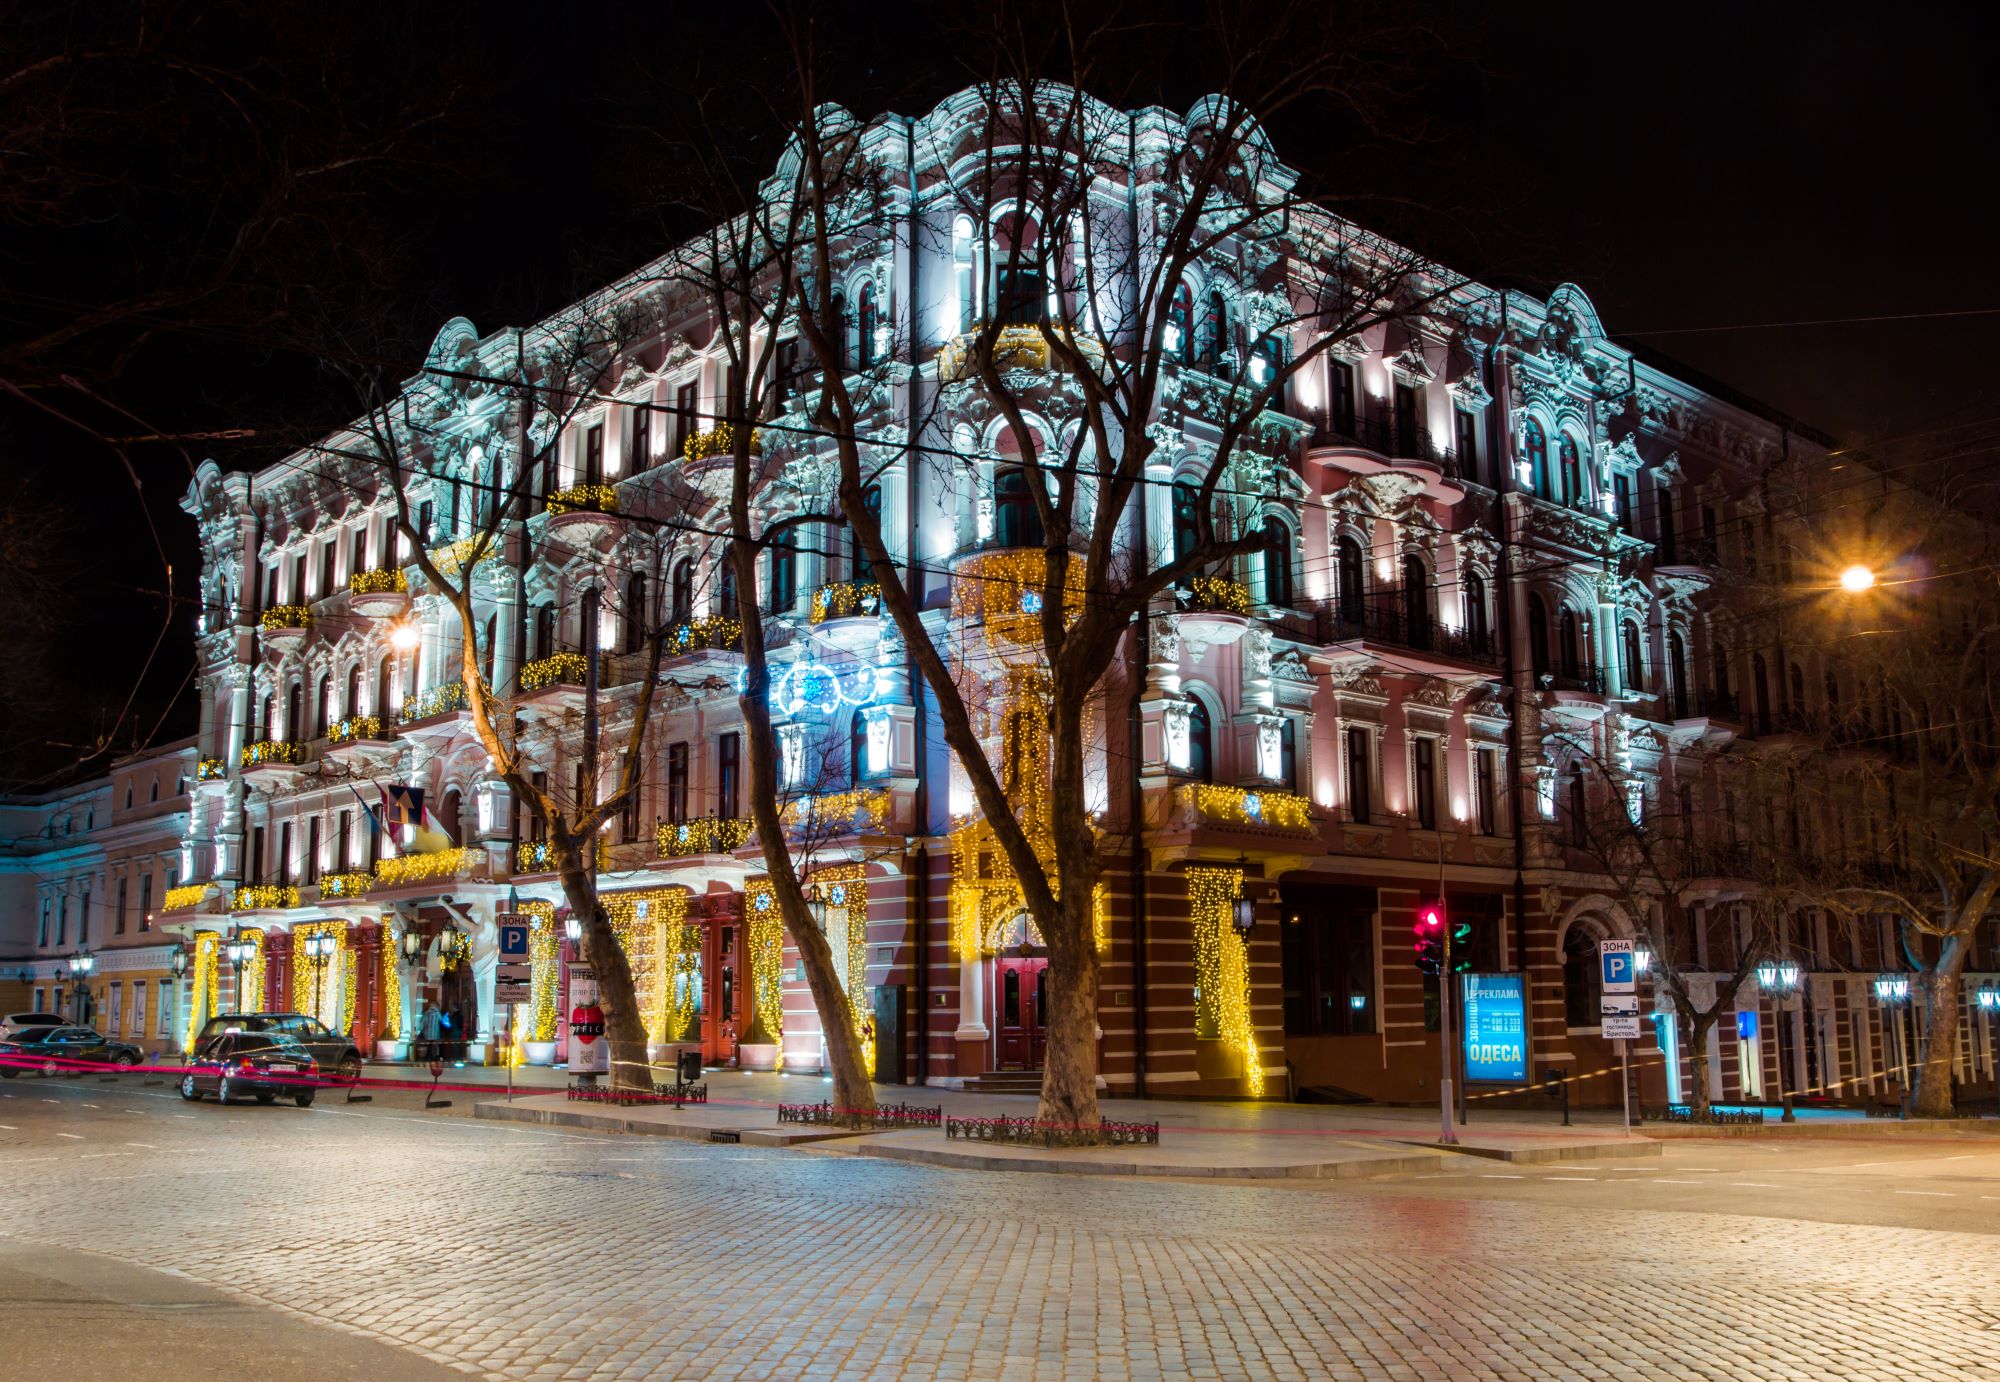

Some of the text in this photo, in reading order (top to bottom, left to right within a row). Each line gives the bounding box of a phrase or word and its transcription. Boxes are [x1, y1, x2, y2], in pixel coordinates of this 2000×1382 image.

[502, 917, 527, 925] ЗОНА
[507, 930, 521, 950] P
[1603, 942, 1631, 951] ЗОНА
[1610, 958, 1625, 978] P
[1479, 989, 1520, 999] РЕКЛАМА
[1470, 1043, 1521, 1065] ОДЕСА
